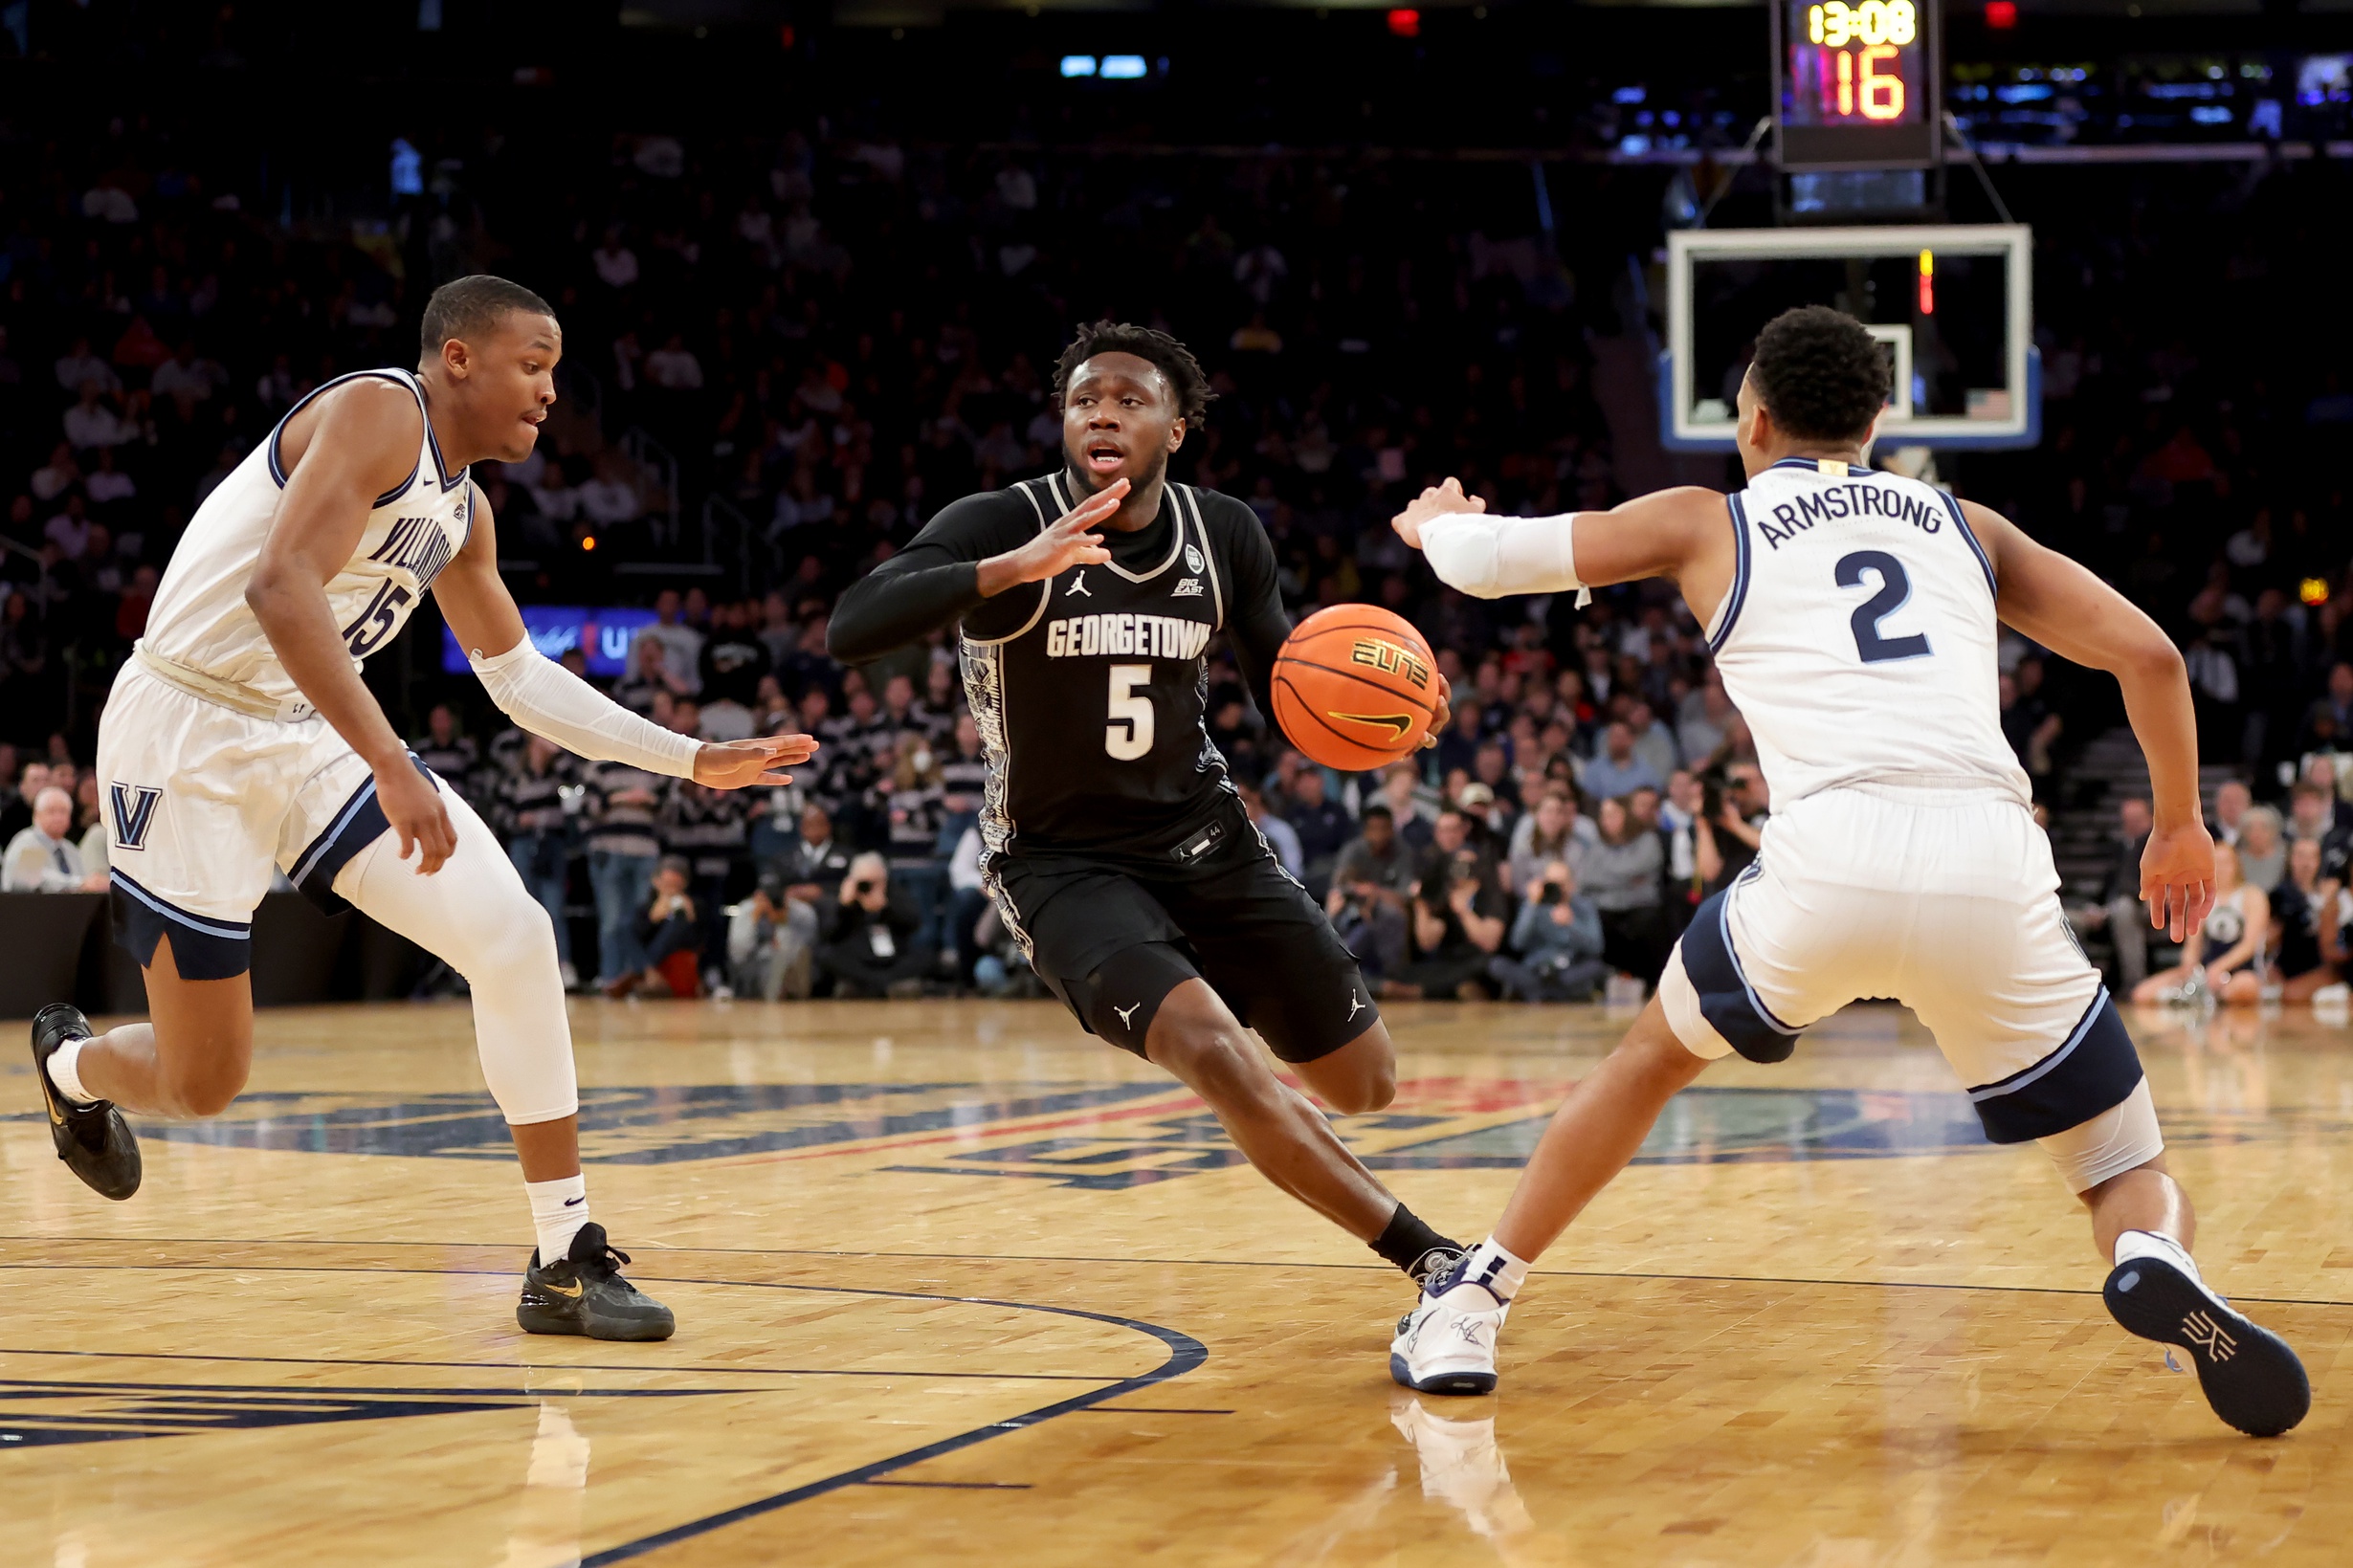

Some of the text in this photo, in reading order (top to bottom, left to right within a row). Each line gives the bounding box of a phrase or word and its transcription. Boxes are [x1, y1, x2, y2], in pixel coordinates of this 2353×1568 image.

[1809, 0, 1917, 47] 13:08
[1837, 44, 1905, 119] 16
[1757, 484, 1943, 551] ARMSTRONG
[1174, 585, 1205, 594] EAST
[1178, 578, 1199, 586] BIG
[1834, 550, 1935, 664] 2
[342, 577, 411, 657] 15
[1351, 640, 1430, 692] ELITE
[1105, 664, 1155, 762] 5
[110, 781, 163, 851] V
